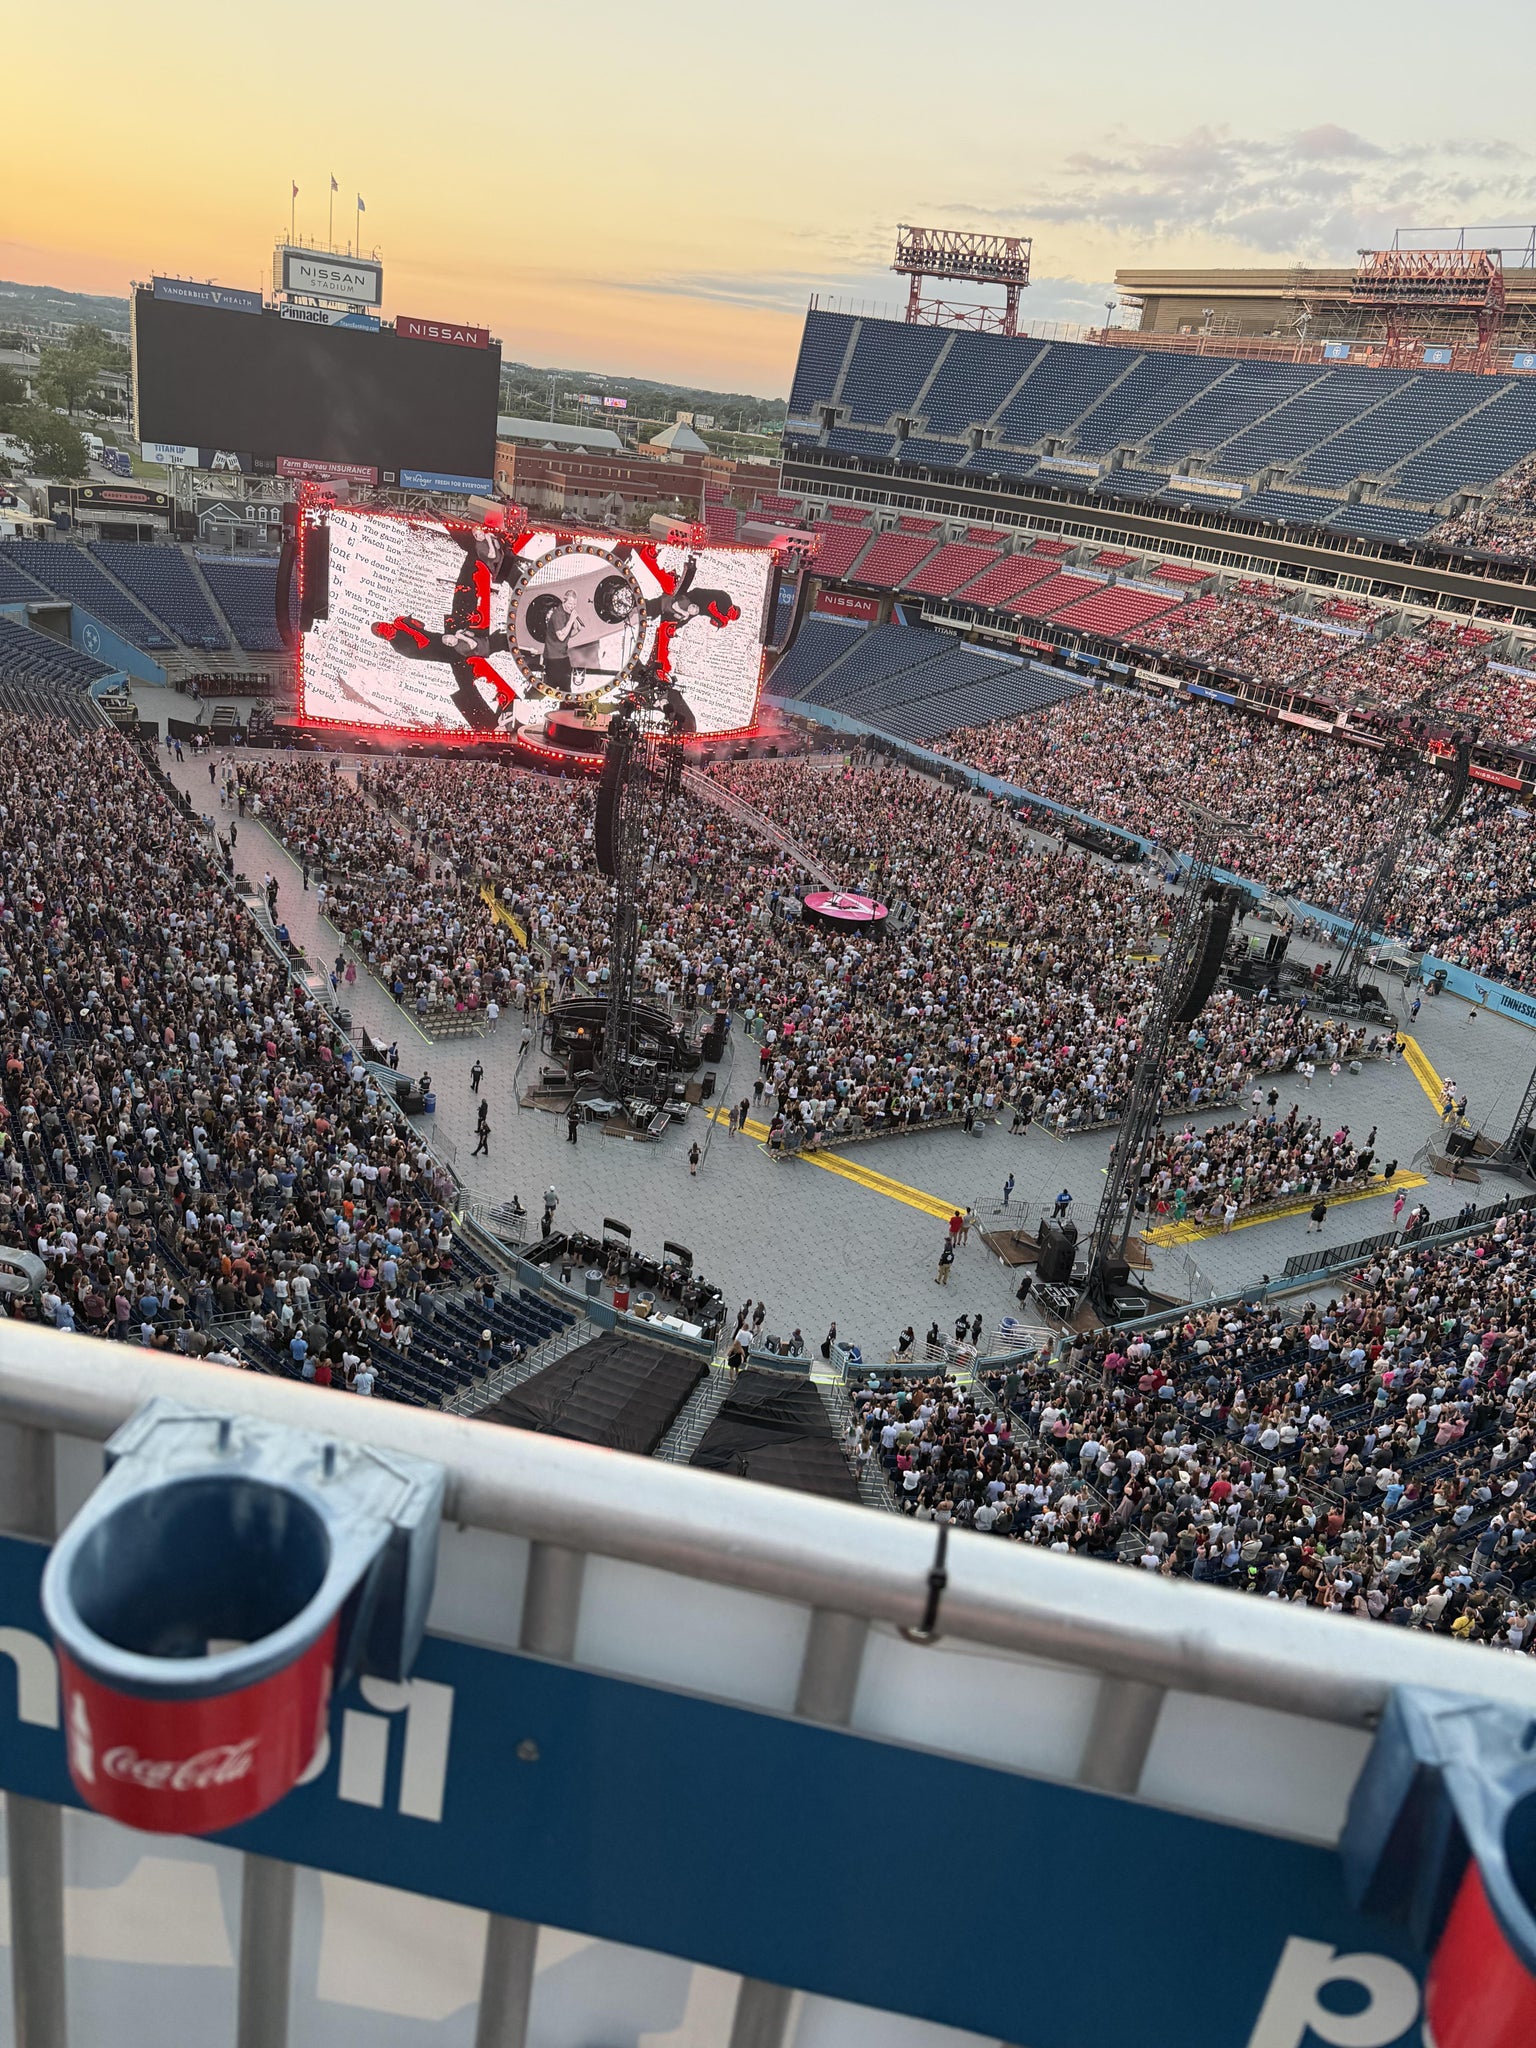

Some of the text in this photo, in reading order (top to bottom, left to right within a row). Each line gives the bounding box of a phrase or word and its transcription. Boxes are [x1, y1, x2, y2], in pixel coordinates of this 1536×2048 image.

[300, 265, 365, 286] NISSAN
[310, 279, 354, 293] STADIUM
[162, 286, 210, 300] VANDERBILT
[223, 296, 252, 307] HEALTH
[281, 304, 329, 324] Pinnacle
[409, 323, 477, 344] NISSAN
[154, 444, 186, 454] TITAN UP
[282, 459, 301, 468] Farm
[302, 461, 328, 470] Bureau
[328, 464, 372, 475] INSURANCE
[412, 473, 432, 487] Kroger
[824, 595, 872, 610] NISSAN
[934, 626, 958, 637] TITANS
[1474, 770, 1500, 782] NISSAN
